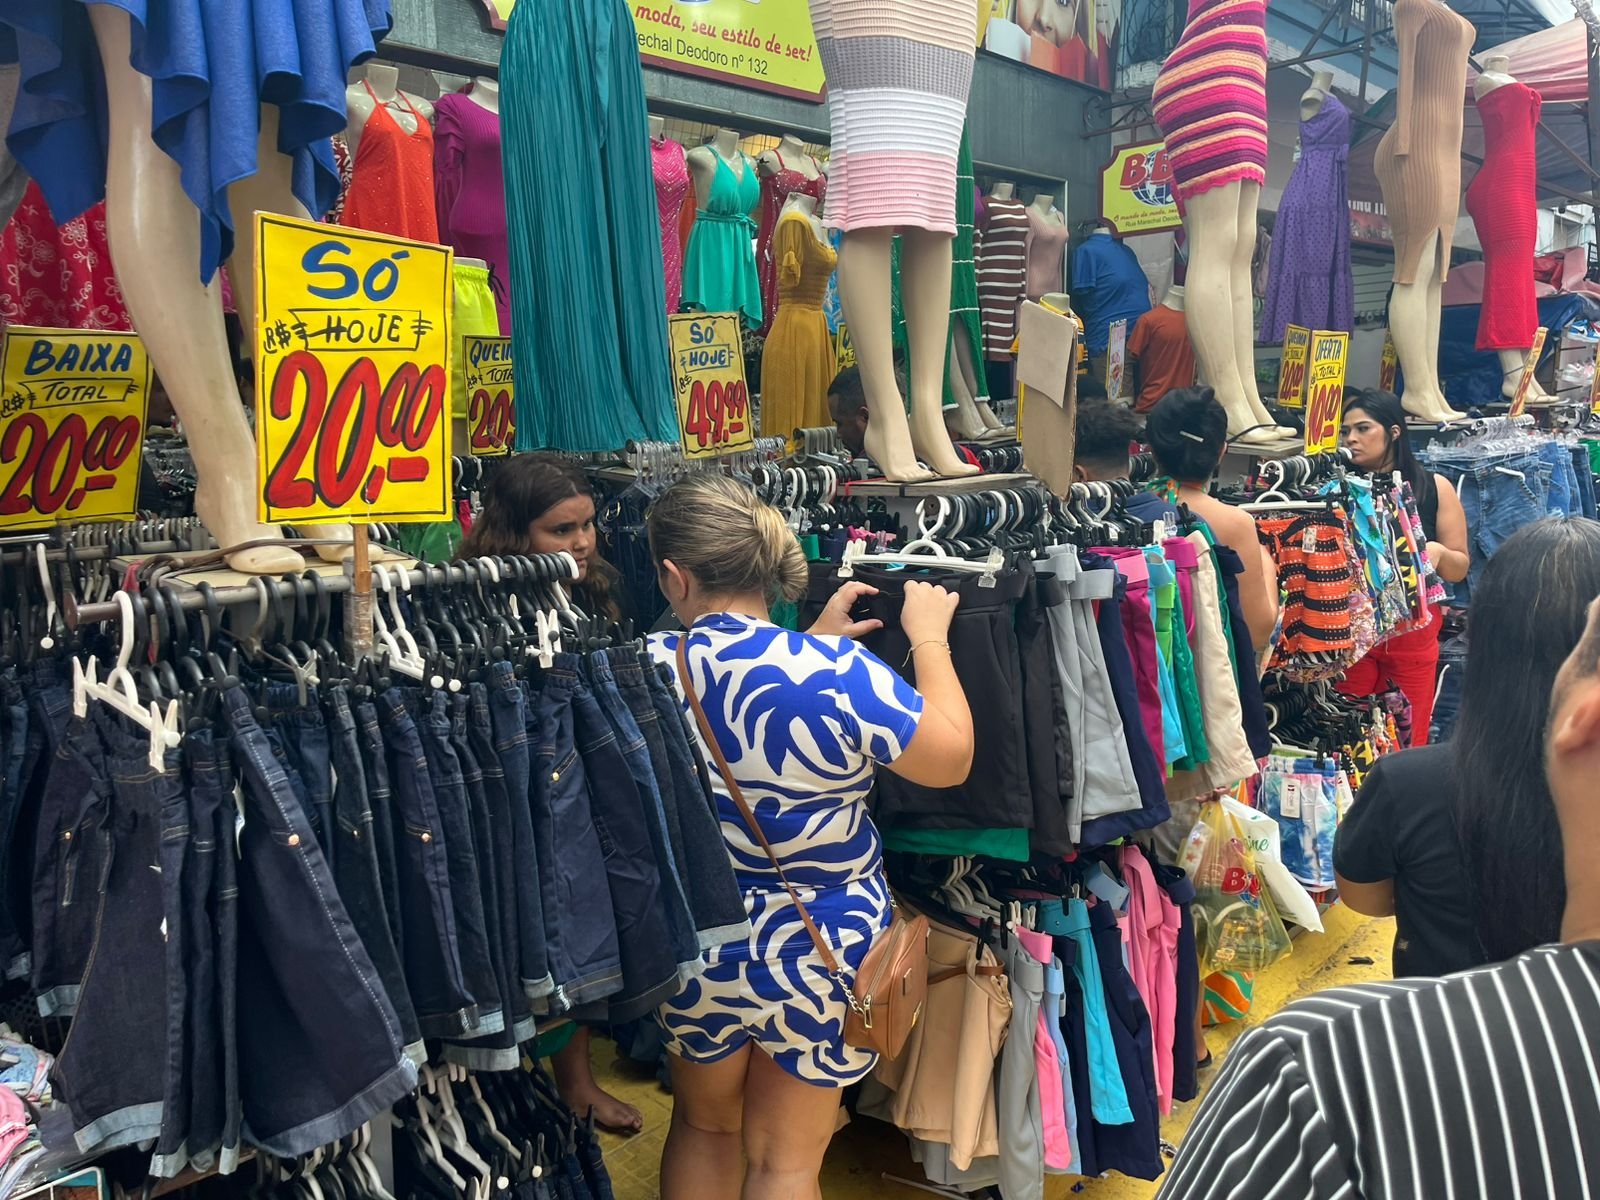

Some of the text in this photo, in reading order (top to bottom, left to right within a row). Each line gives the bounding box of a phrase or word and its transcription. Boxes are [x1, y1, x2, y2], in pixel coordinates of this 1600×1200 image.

[636, 5, 812, 62] moda, seu estilo de ser!
[677, 39, 728, 66] Deodoro
[748, 57, 768, 75] 132
[302, 240, 410, 301] SÓ
[264, 313, 403, 353] R$ HOJE
[690, 320, 716, 344] SÓ
[24, 340, 132, 375] BAIXA
[689, 350, 726, 366] HOJE
[1315, 339, 1342, 362] OFERTA
[1319, 366, 1335, 378] TOTAL
[42, 382, 108, 401] TOTAL
